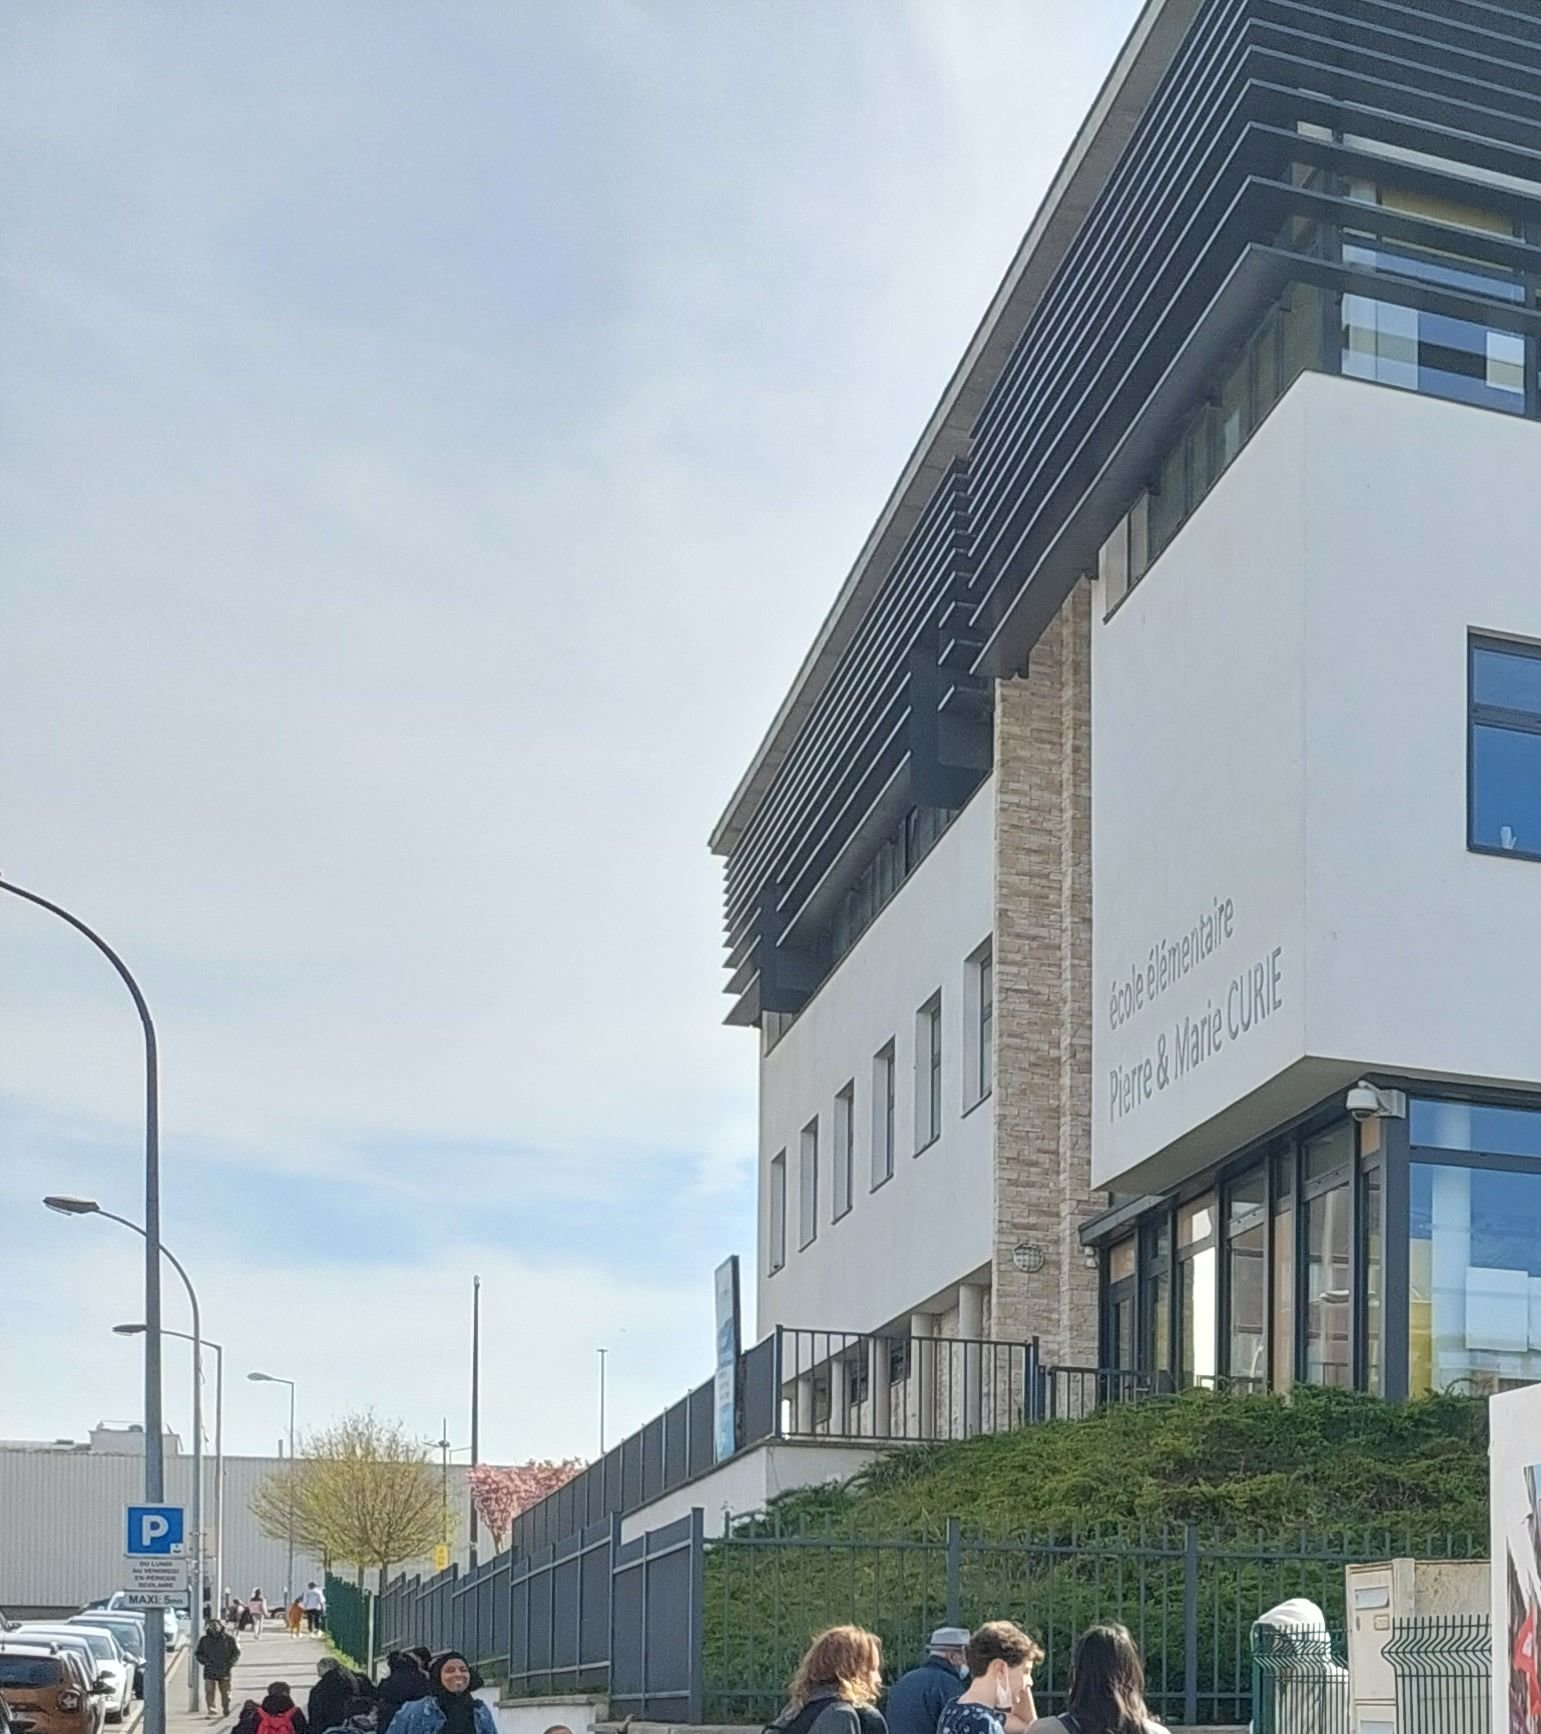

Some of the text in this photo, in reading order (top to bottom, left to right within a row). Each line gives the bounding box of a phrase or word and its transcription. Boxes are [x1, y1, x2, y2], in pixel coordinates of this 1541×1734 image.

[1109, 896, 1234, 1030] école élémentaire
[1109, 946, 1282, 1123] Pierre & Marie CURIE
[142, 1515, 169, 1547] P
